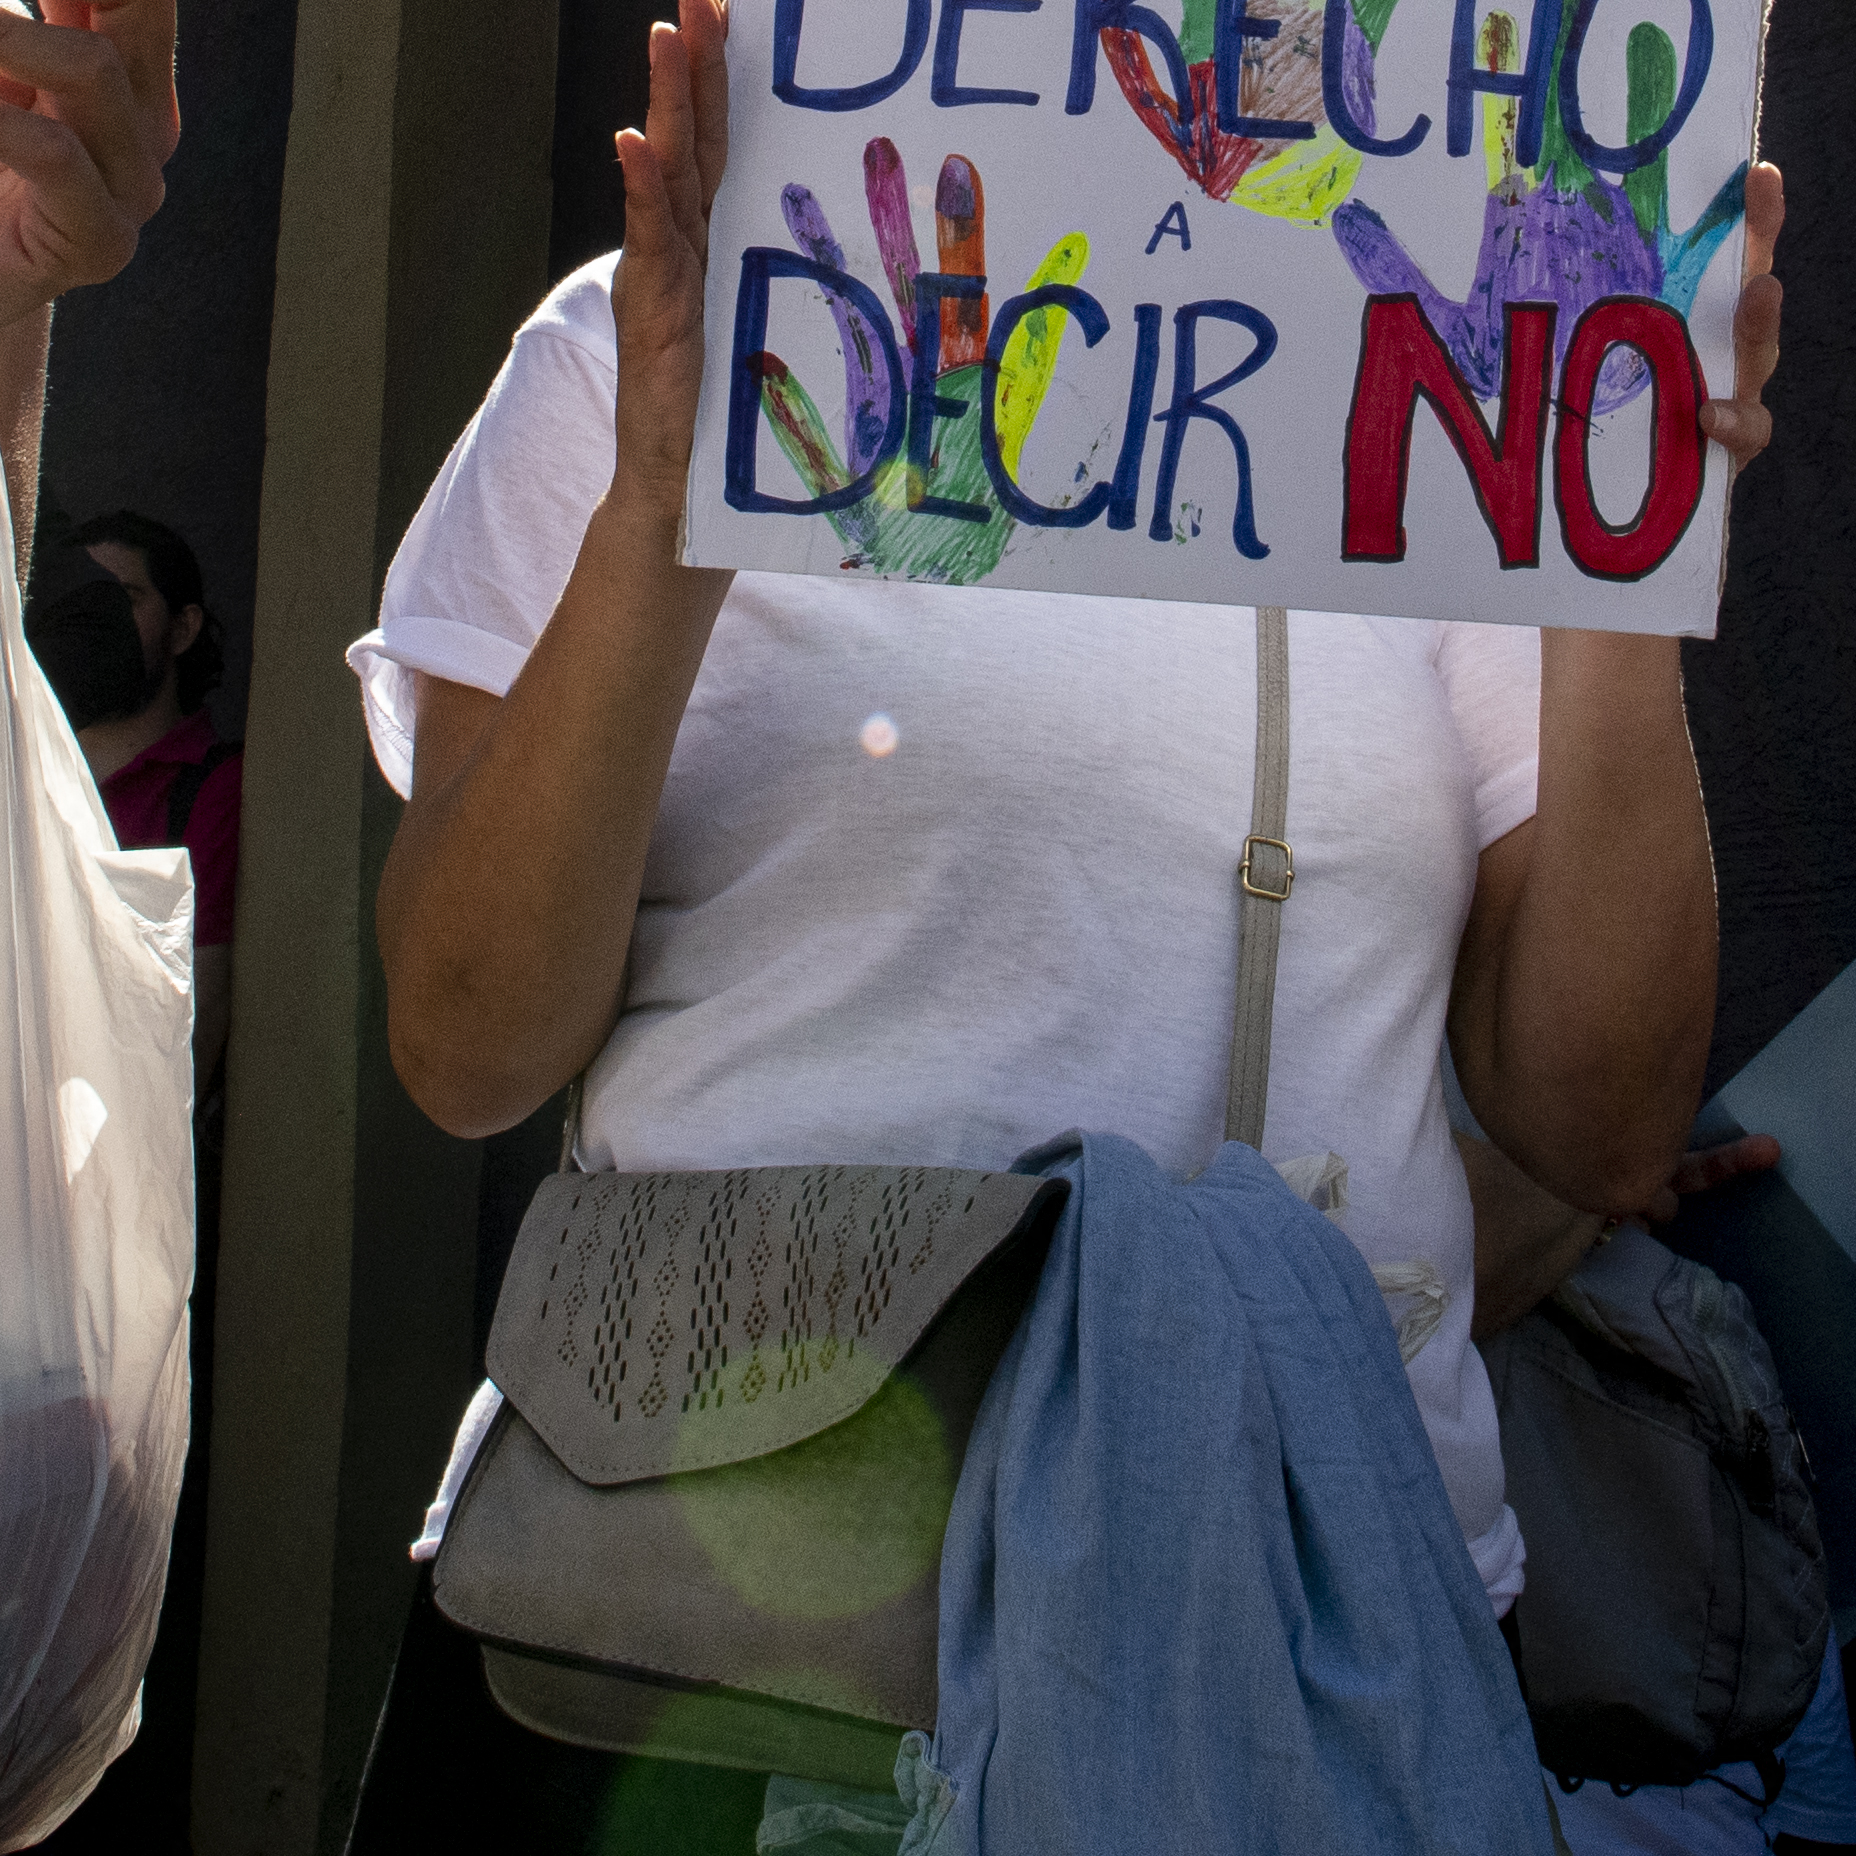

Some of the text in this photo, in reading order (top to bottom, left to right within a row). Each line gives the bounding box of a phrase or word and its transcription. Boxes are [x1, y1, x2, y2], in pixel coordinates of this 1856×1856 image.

[1145, 200, 1192, 255] A
[725, 246, 1709, 581] DECIR NO
